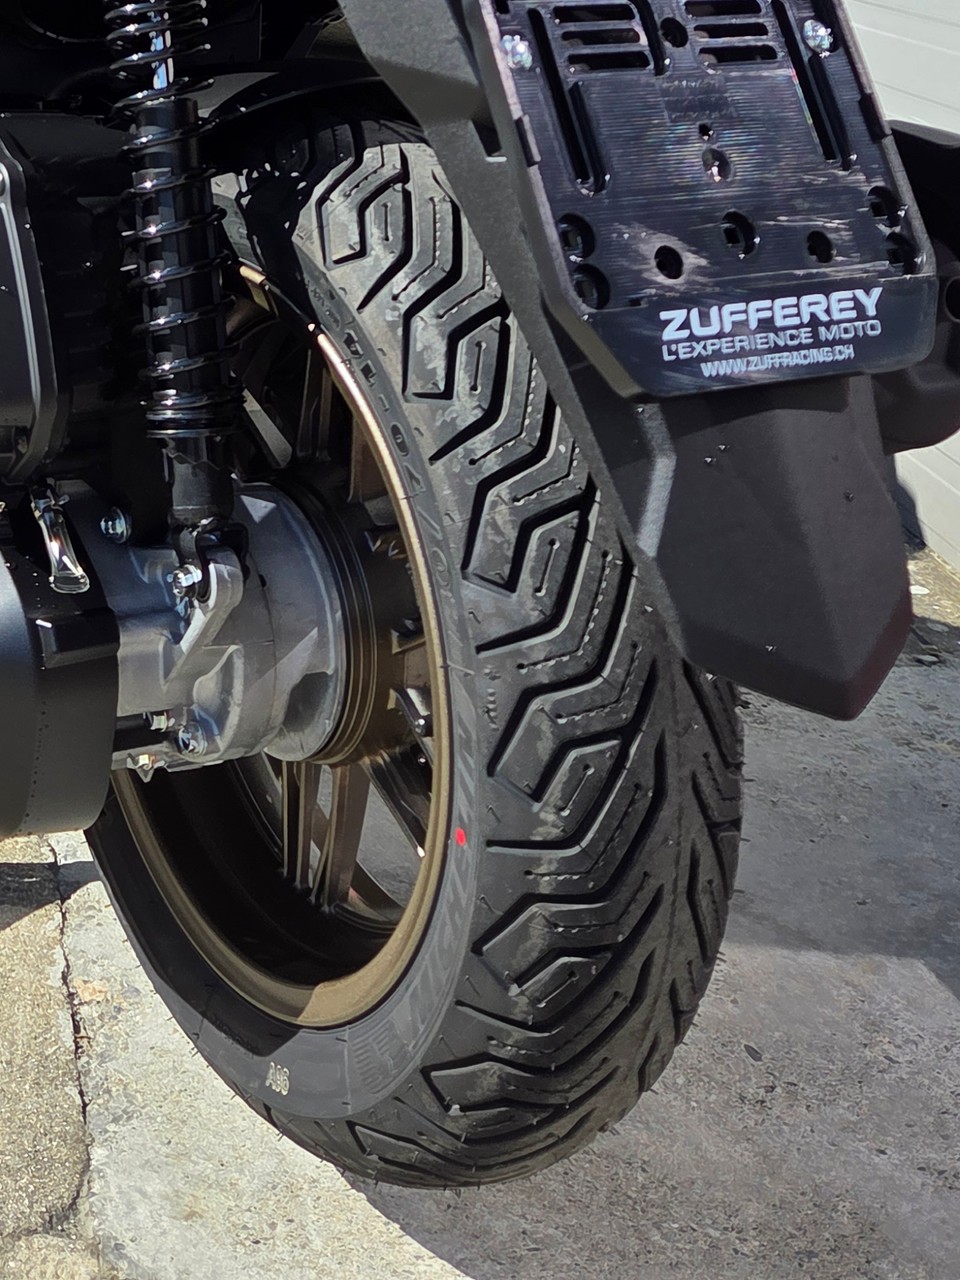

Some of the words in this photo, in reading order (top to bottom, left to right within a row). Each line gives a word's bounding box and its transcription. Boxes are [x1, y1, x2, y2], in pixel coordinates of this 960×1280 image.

[659, 287, 884, 341] ZUFFEREY
[661, 327, 814, 362] L'EXPERIENCE
[818, 319, 882, 342] MOTO
